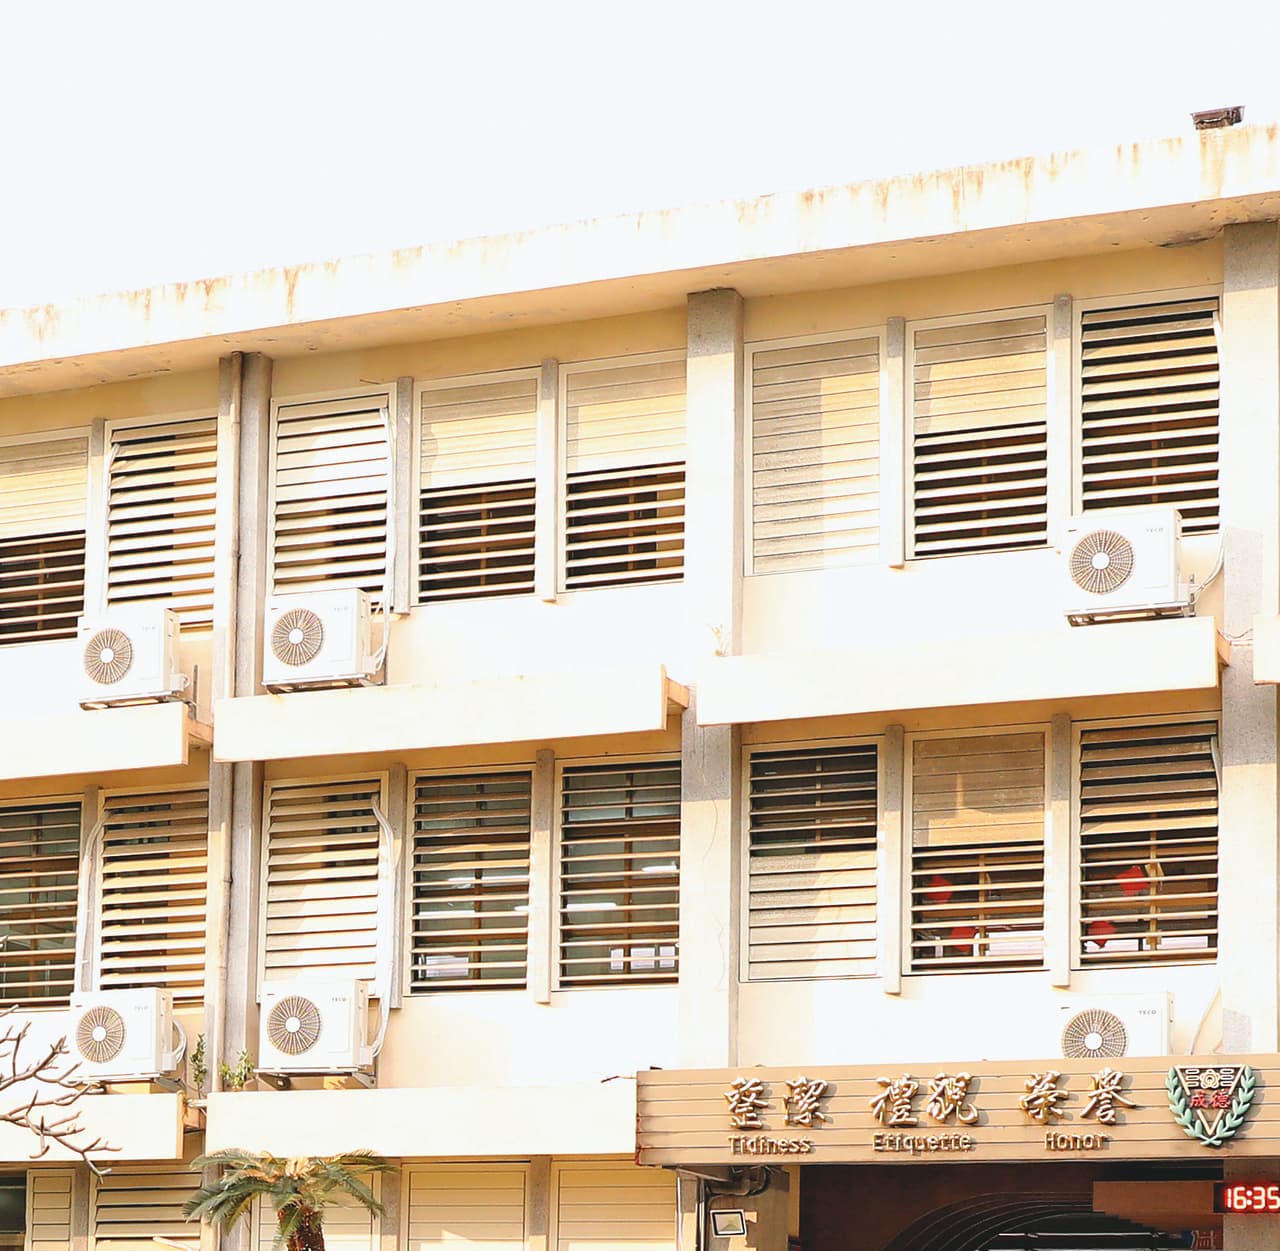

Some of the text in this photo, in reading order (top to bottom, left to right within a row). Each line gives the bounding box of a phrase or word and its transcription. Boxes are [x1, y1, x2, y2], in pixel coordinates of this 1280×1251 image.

[724, 1076, 829, 1128] 整潔
[1019, 1067, 1137, 1125] 榮譽
[729, 1135, 812, 1155] Tidiness
[872, 1132, 973, 1156] Etiquette
[1044, 1131, 1107, 1151] Honor
[1226, 1185, 1280, 1210] 16:35
